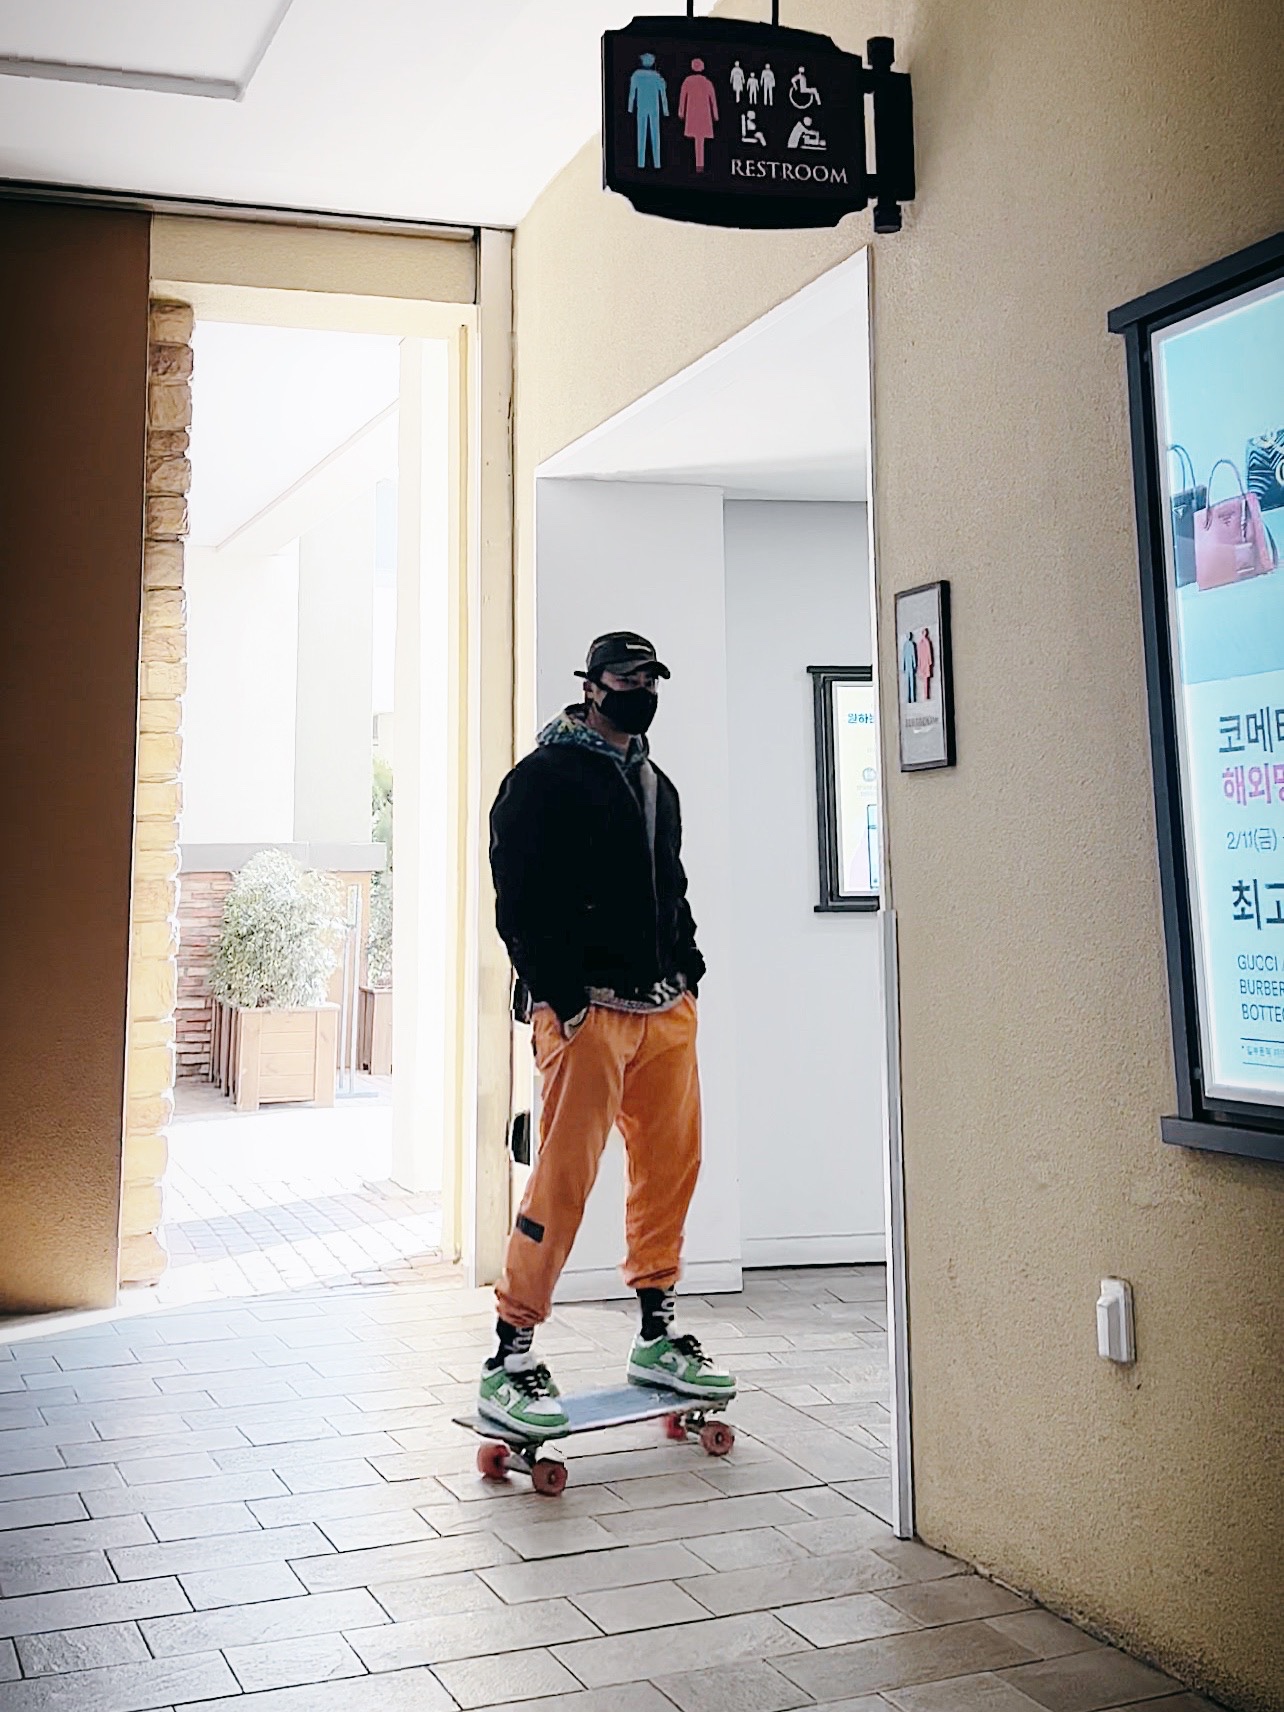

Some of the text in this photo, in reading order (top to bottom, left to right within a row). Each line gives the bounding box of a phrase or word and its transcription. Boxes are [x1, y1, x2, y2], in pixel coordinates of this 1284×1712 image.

[731, 159, 848, 185] RESTROOM
[1226, 828, 1278, 852] 2/11(금)
[1237, 954, 1278, 972] GUCCI
[1242, 1003, 1284, 1023] BOTTE
